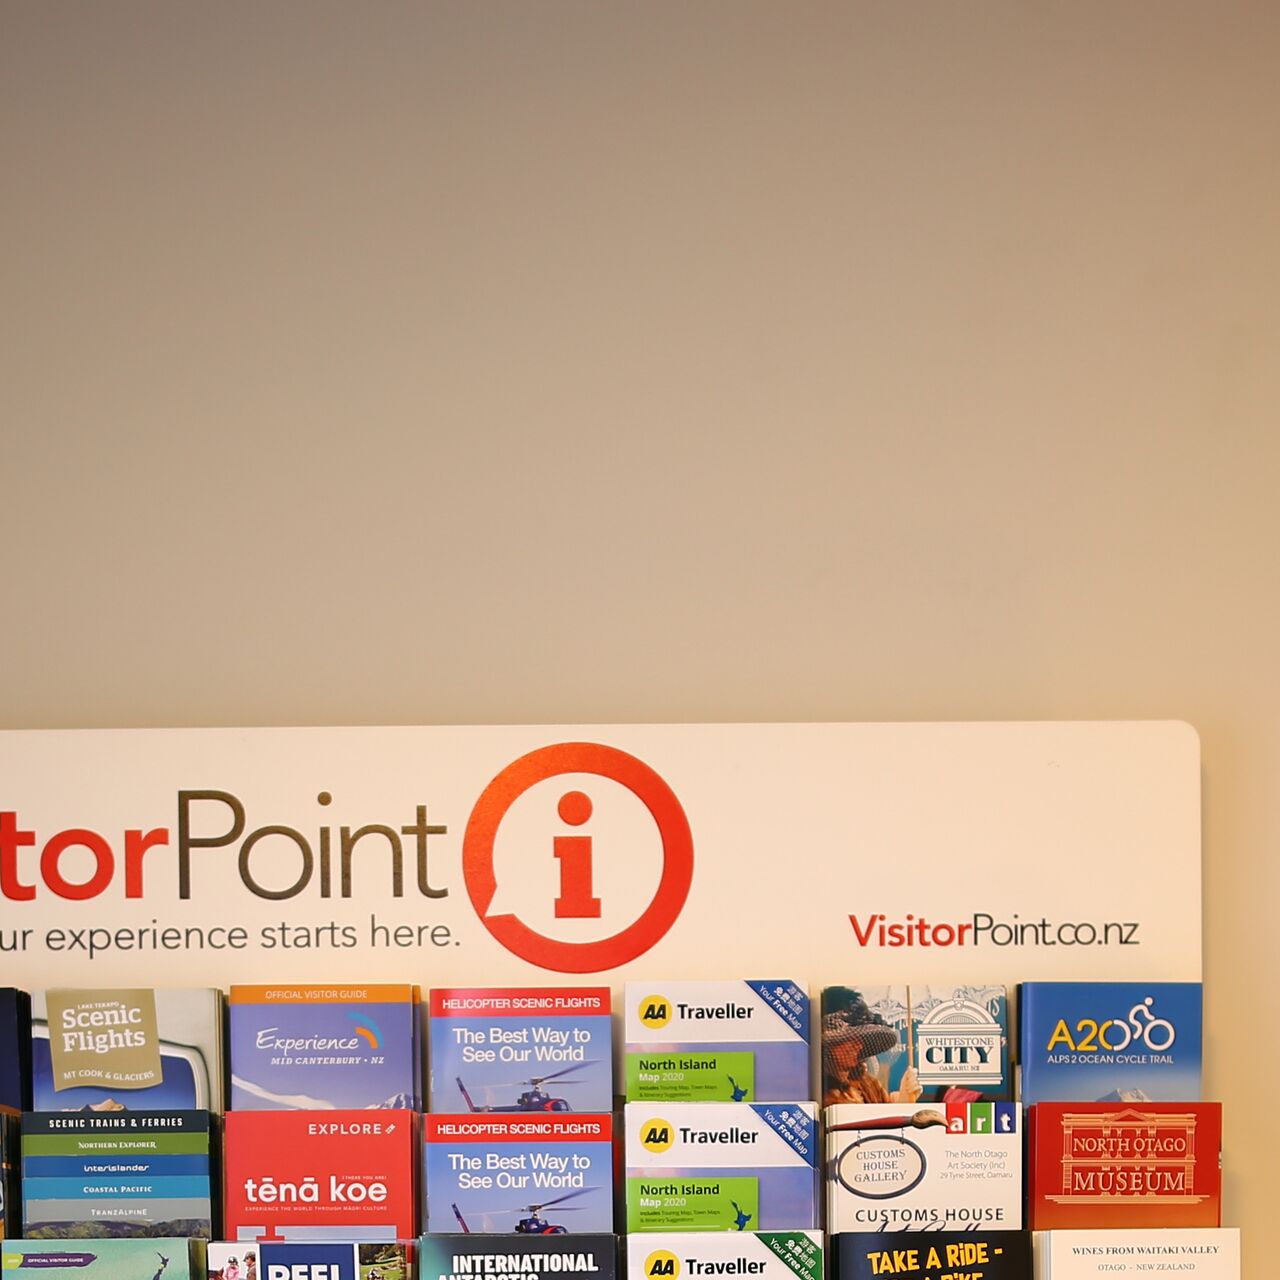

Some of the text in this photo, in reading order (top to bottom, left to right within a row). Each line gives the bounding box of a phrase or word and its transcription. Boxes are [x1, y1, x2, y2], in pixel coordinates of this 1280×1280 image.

[45, 919, 249, 960] experience
[260, 918, 358, 949] starts
[370, 915, 461, 948] here.
[849, 914, 1140, 948] VisitorPoint.co.nz
[265, 989, 368, 999] OFFICIAL VISITOR GUIDE
[442, 997, 600, 1009] HELICOPTER SCENIC FLIGHTS
[62, 1004, 142, 1029] Scenic
[677, 1004, 754, 1020] Traveller
[63, 1027, 146, 1054] Flights
[255, 1027, 360, 1055] Experience
[926, 1037, 994, 1046] WHITESTONE
[295, 1057, 361, 1065] CANTERBURY
[925, 1046, 993, 1064] CITY
[1047, 1054, 1174, 1064] ALPS 2 OCEAN CYCLE TRAIL
[639, 1059, 717, 1070] North Island
[49, 1117, 183, 1129] SCENIC TRAINS & FERRIES
[308, 1123, 383, 1135] EXPLORE
[1073, 1137, 1186, 1154] NORTH OTAGO
[330, 1176, 388, 1202] koe
[1073, 1171, 1185, 1191] MUSEUM
[855, 1208, 1004, 1222] CUSTOMS HOUSE
[1072, 1245, 1220, 1255] WINES FROM WAITAKI VALLEY
[452, 1254, 599, 1273] INTERNATIONAL
